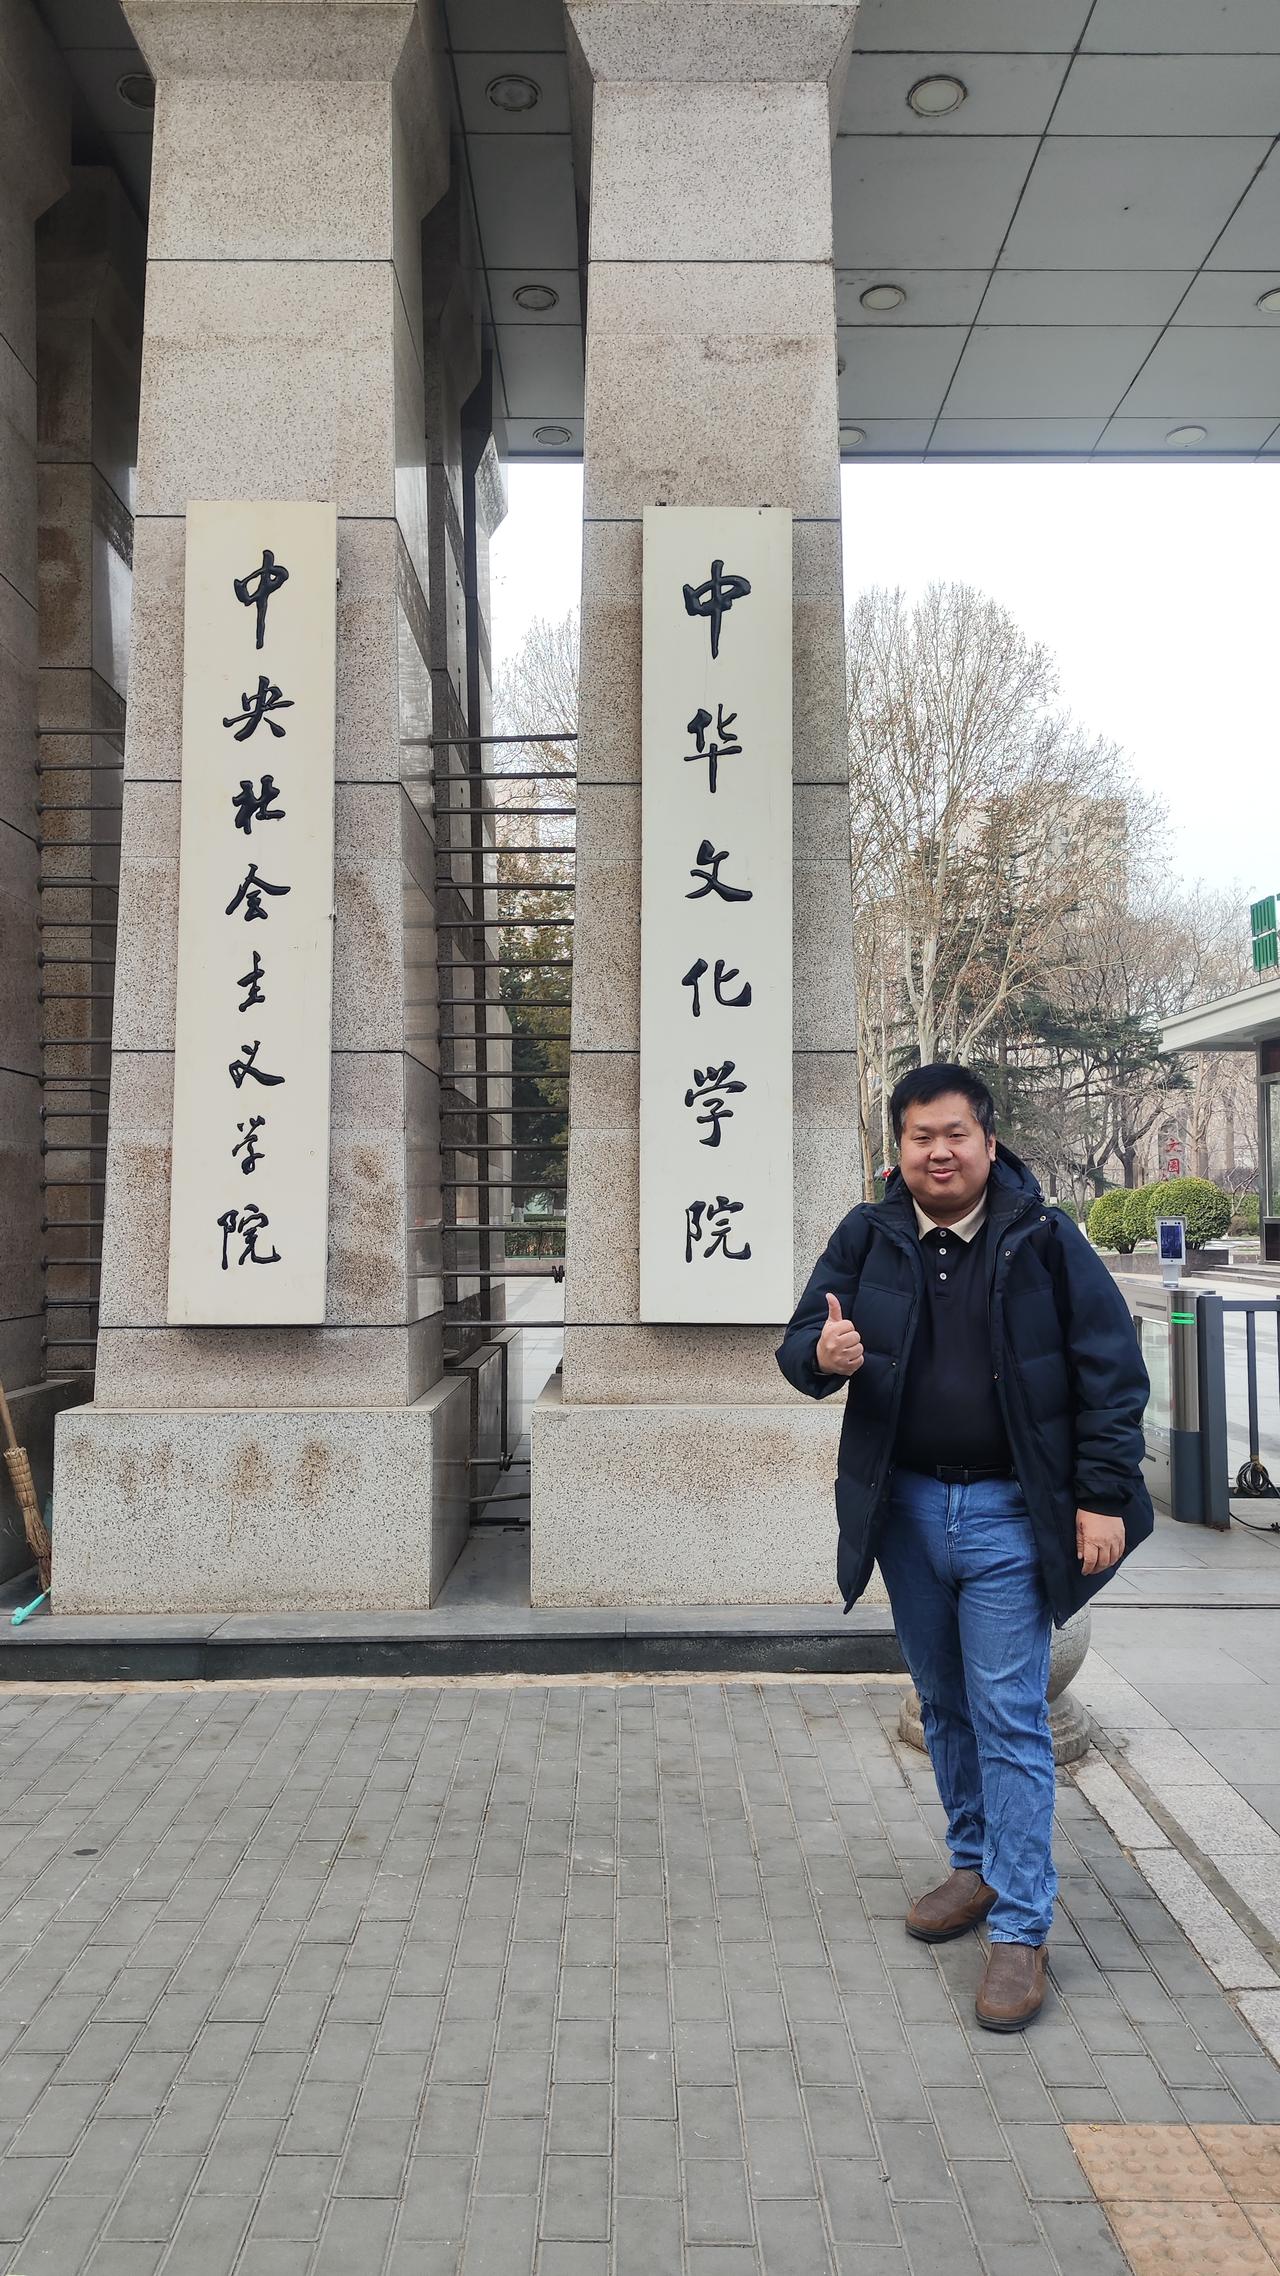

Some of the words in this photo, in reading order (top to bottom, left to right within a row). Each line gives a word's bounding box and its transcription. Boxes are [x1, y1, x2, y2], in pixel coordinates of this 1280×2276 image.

[218, 550, 294, 1270] 中央社会主义学院
[682, 559, 754, 1263] 中华文化学院
